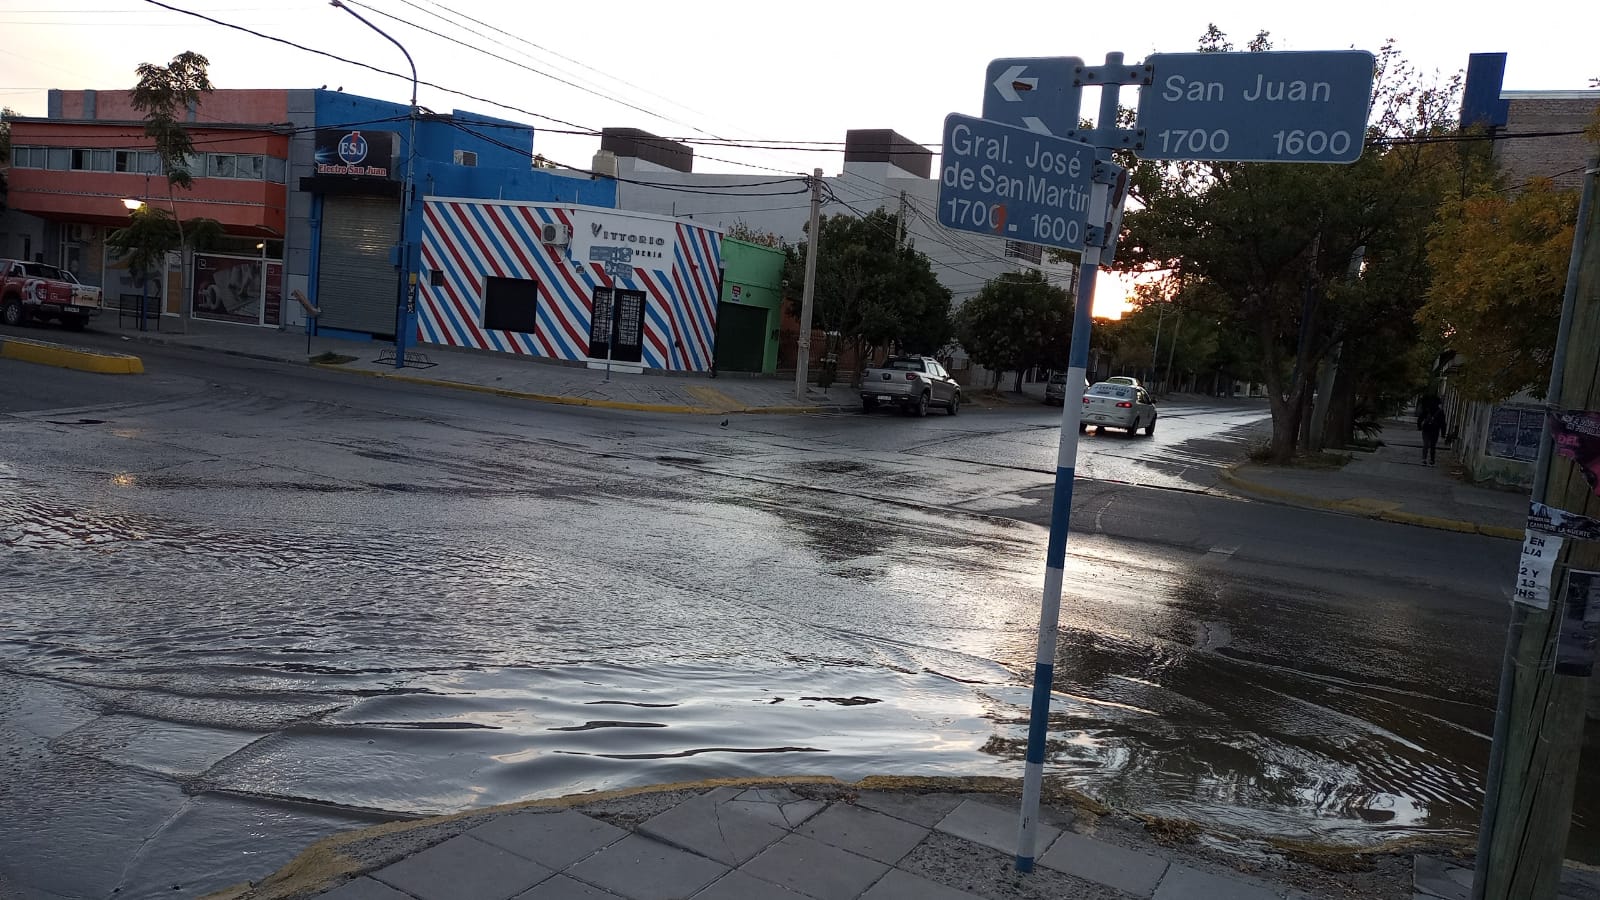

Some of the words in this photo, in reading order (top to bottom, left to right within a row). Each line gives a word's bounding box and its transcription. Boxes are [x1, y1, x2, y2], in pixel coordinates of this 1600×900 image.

[1162, 74, 1224, 101] San
[1243, 73, 1331, 101] Juan
[341, 142, 365, 155] ESJ
[951, 124, 1014, 164] Gral.
[1025, 141, 1081, 178] José
[1158, 128, 1230, 153] 1700
[1272, 129, 1351, 155] 1600
[318, 164, 348, 175] Electro
[347, 165, 365, 175] San
[365, 165, 387, 177] Juan
[943, 161, 976, 190] de
[978, 164, 1024, 200] San
[1026, 175, 1090, 213] Martín
[1031, 213, 1079, 244] 1600
[1529, 536, 1546, 547] EN
[1521, 579, 1536, 588] 13
[1532, 569, 1539, 579] Y
